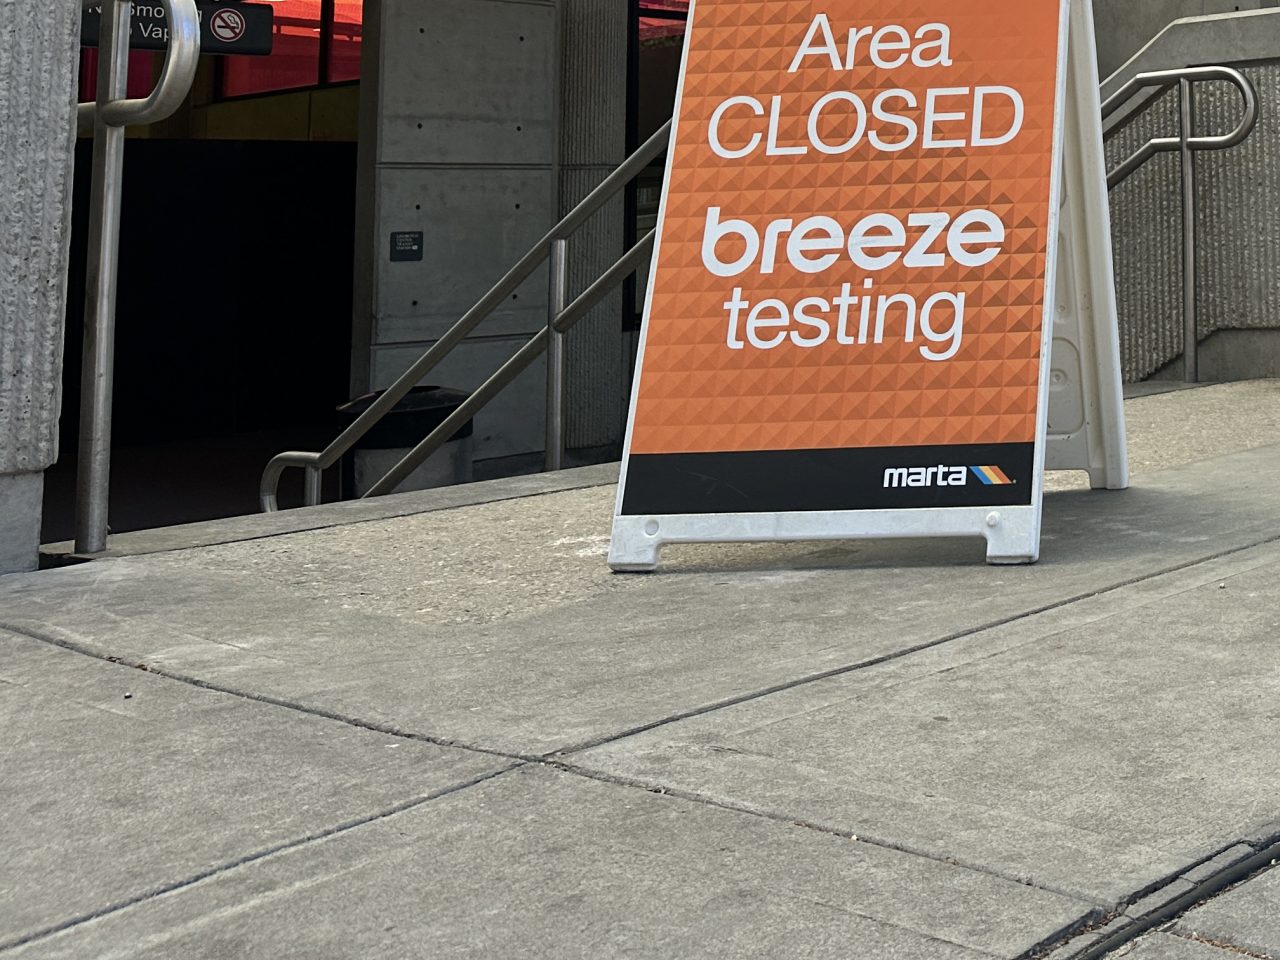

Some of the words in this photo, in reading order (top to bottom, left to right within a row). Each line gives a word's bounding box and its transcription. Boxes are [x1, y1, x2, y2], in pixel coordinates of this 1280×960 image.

[789, 13, 953, 73] Area
[706, 86, 1026, 160] CLOSED
[700, 206, 1006, 279] breeze
[722, 278, 967, 361] testing
[883, 464, 967, 488] marta
